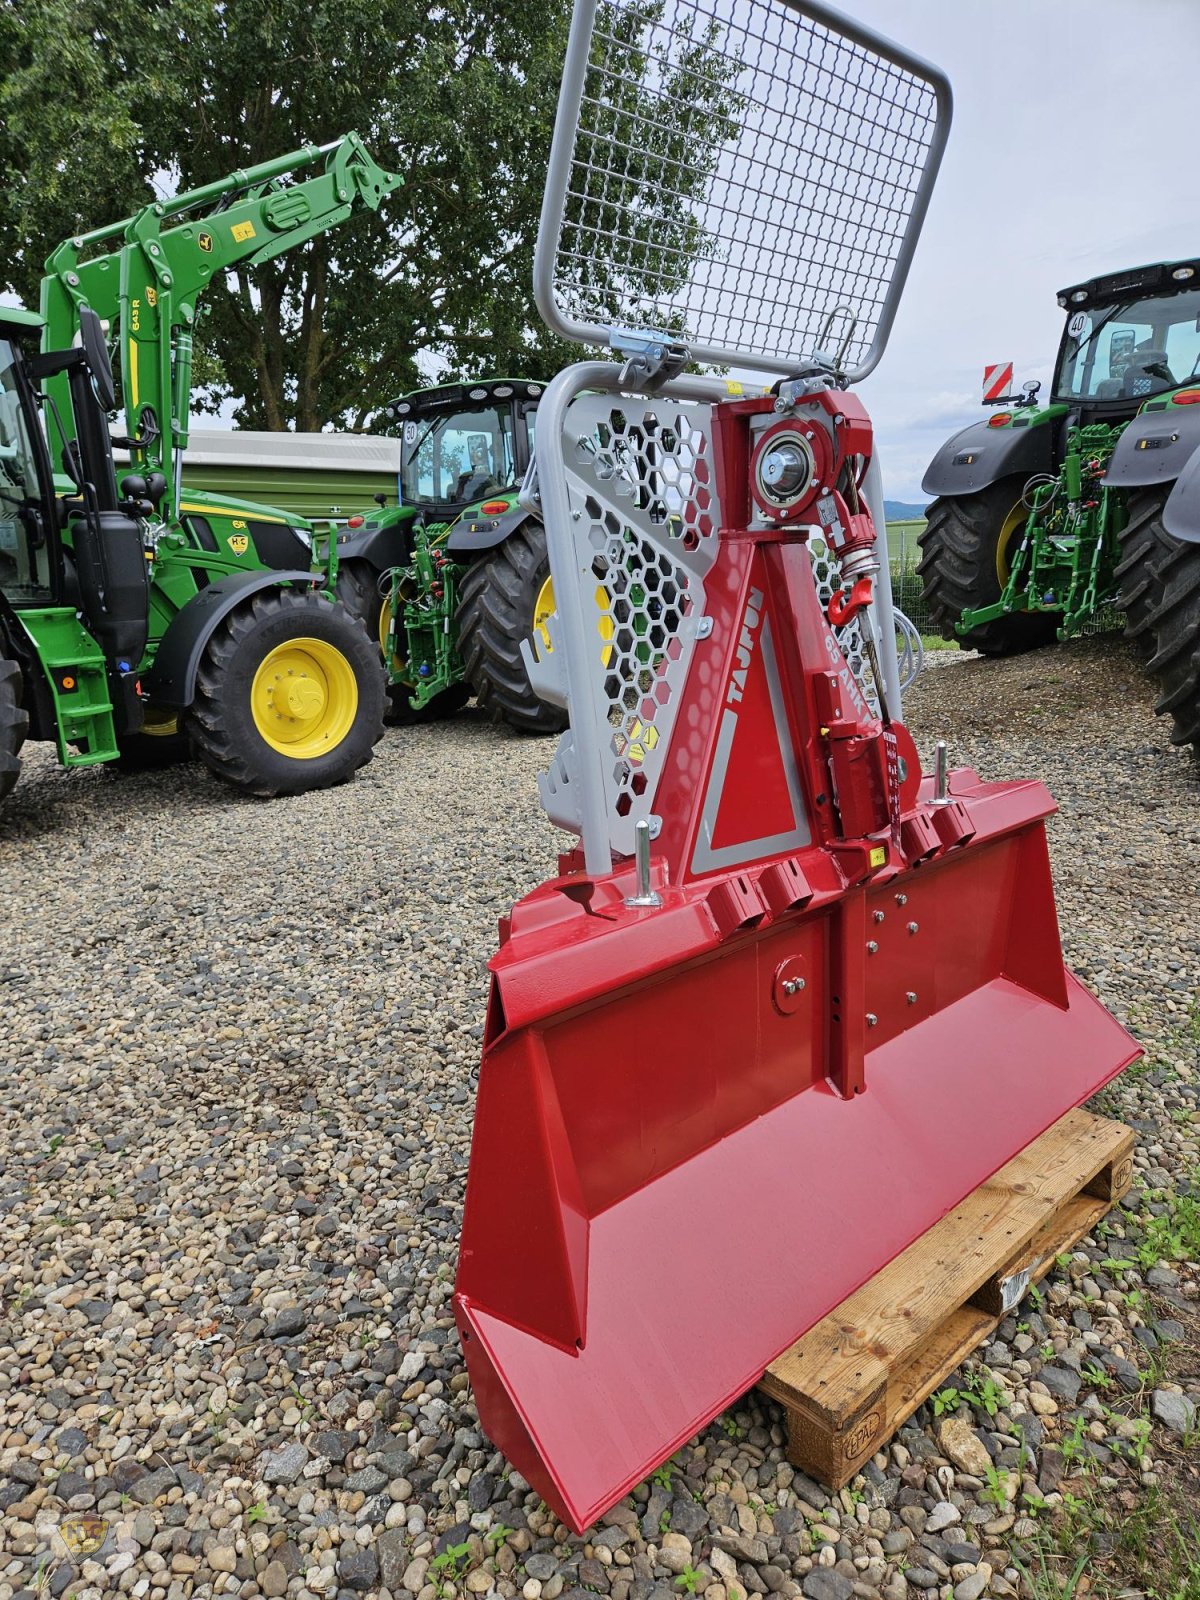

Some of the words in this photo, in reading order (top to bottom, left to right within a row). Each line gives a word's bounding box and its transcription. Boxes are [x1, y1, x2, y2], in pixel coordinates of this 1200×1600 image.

[132, 310, 140, 331] 643
[1071, 315, 1085, 332] 40
[406, 425, 415, 440] 50
[726, 585, 765, 704] TAJFUN
[825, 635, 840, 664] 65
[838, 668, 864, 715] AHK
